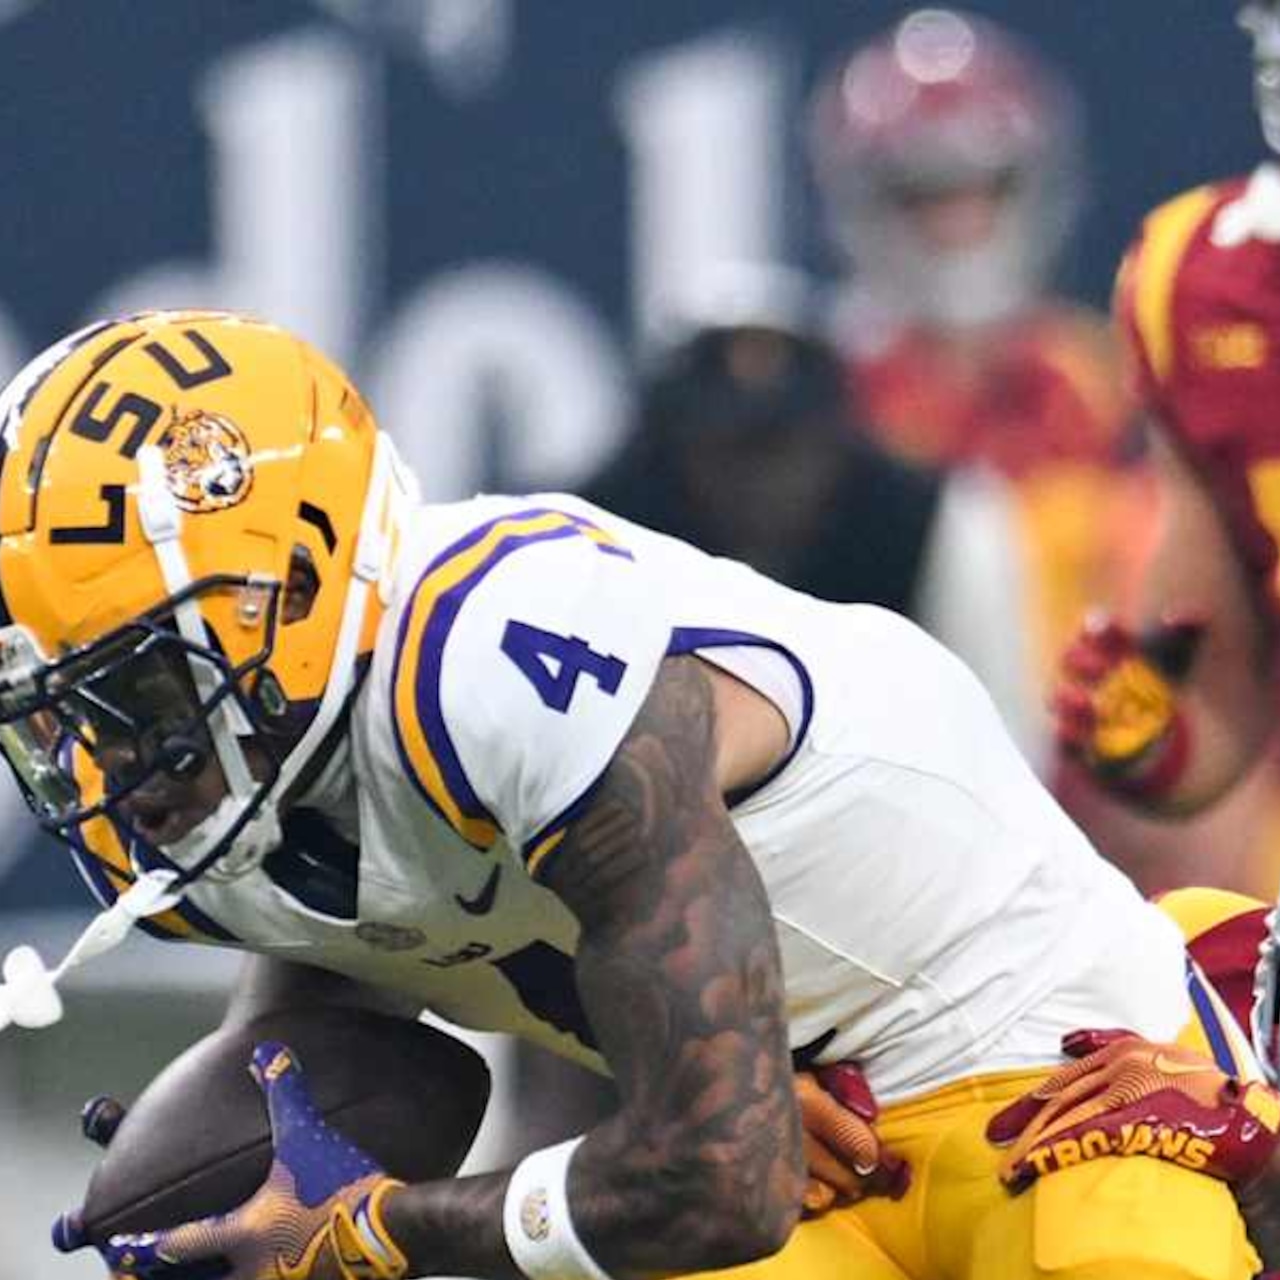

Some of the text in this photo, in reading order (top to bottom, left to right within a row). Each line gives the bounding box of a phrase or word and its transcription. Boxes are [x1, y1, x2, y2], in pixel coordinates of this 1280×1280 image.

[50, 330, 231, 544] LSU
[499, 619, 628, 714] 4
[1025, 1122, 1216, 1175] TROJANS
